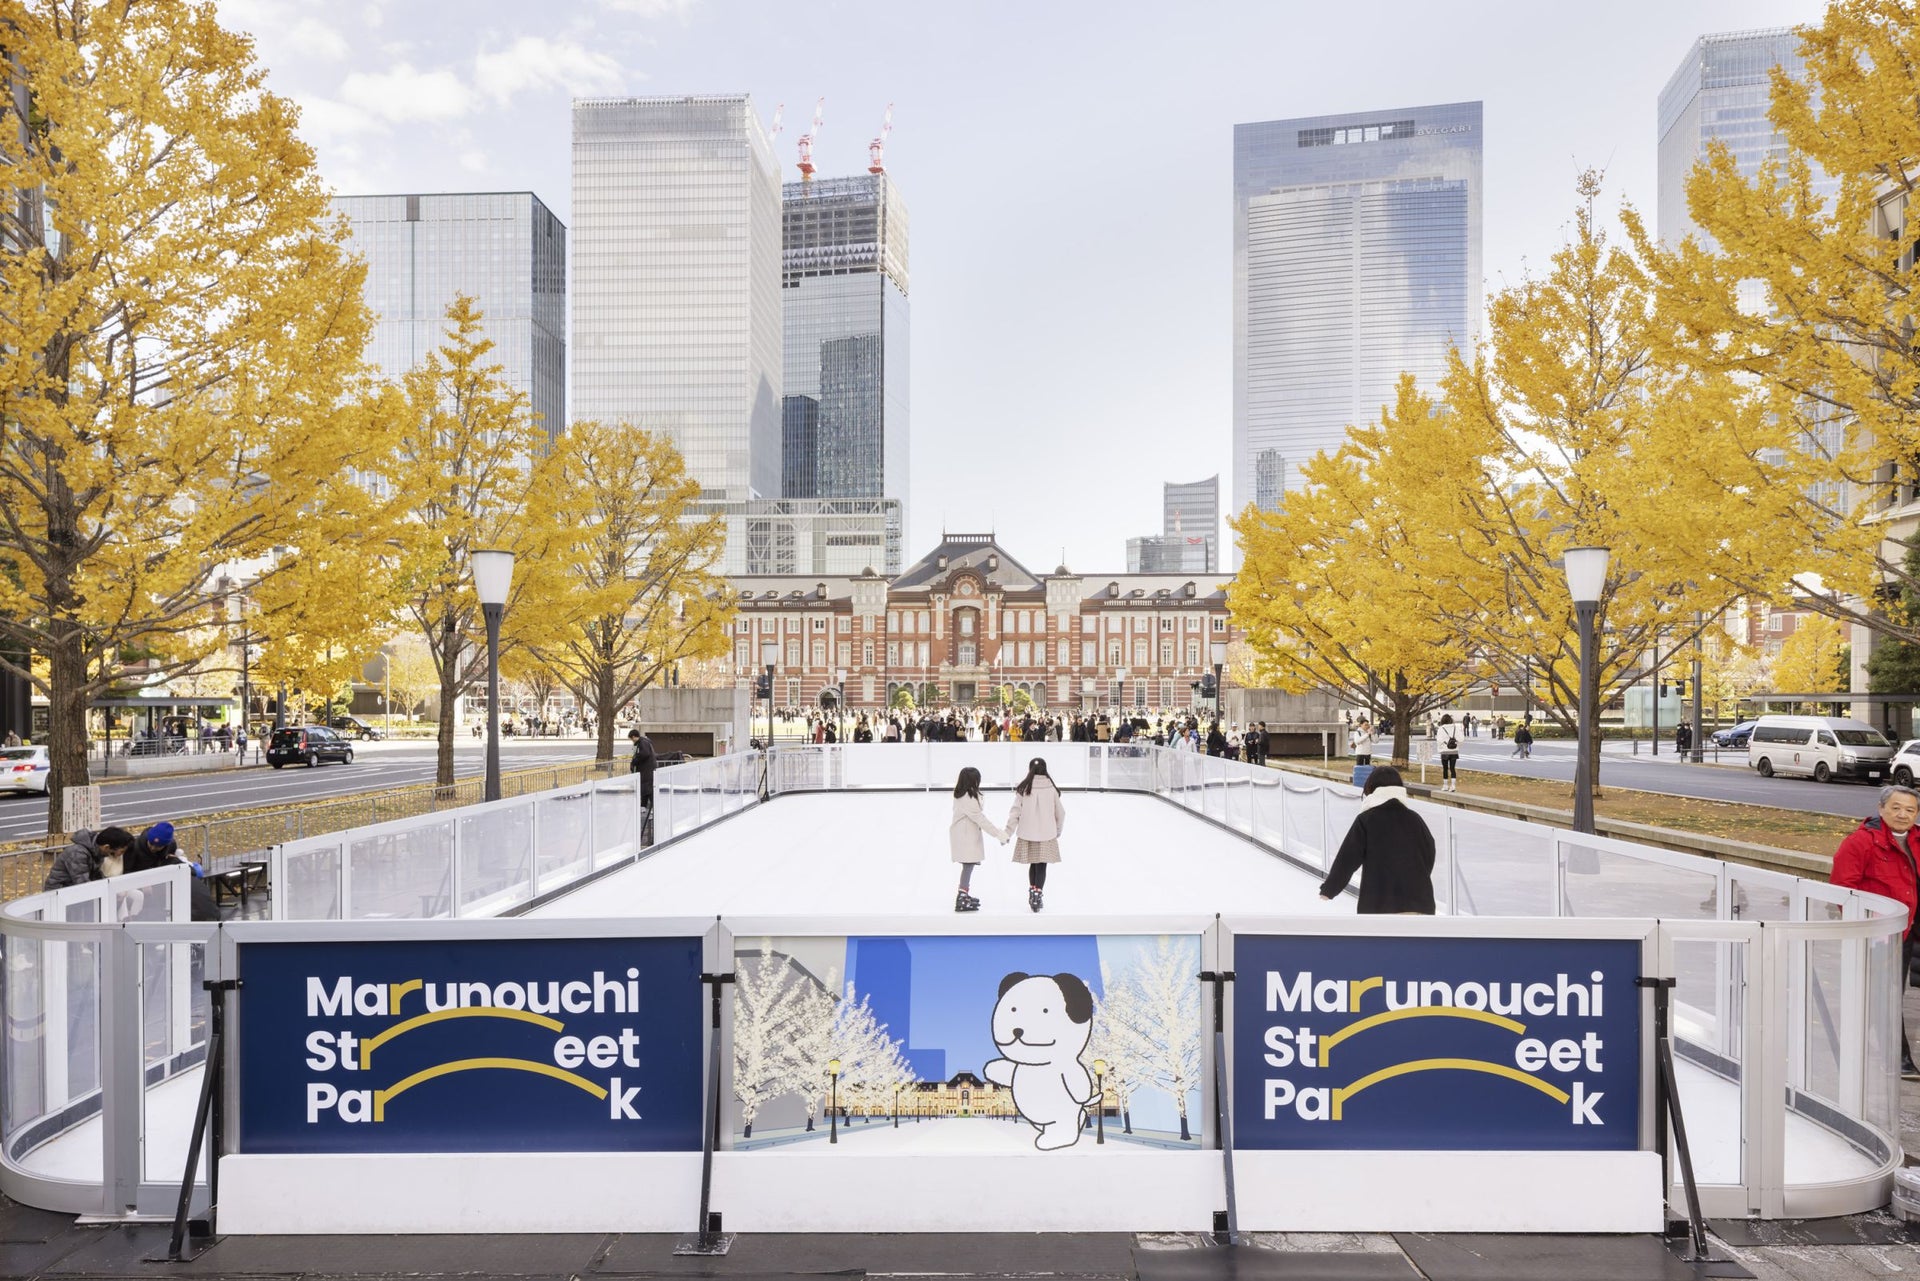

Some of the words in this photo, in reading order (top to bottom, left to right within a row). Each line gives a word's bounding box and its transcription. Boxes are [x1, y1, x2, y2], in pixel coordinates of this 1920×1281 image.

[1417, 125, 1471, 136] BVLGARI
[306, 967, 640, 1016] Marunouchi
[1265, 970, 1603, 1017] Marunouchi
